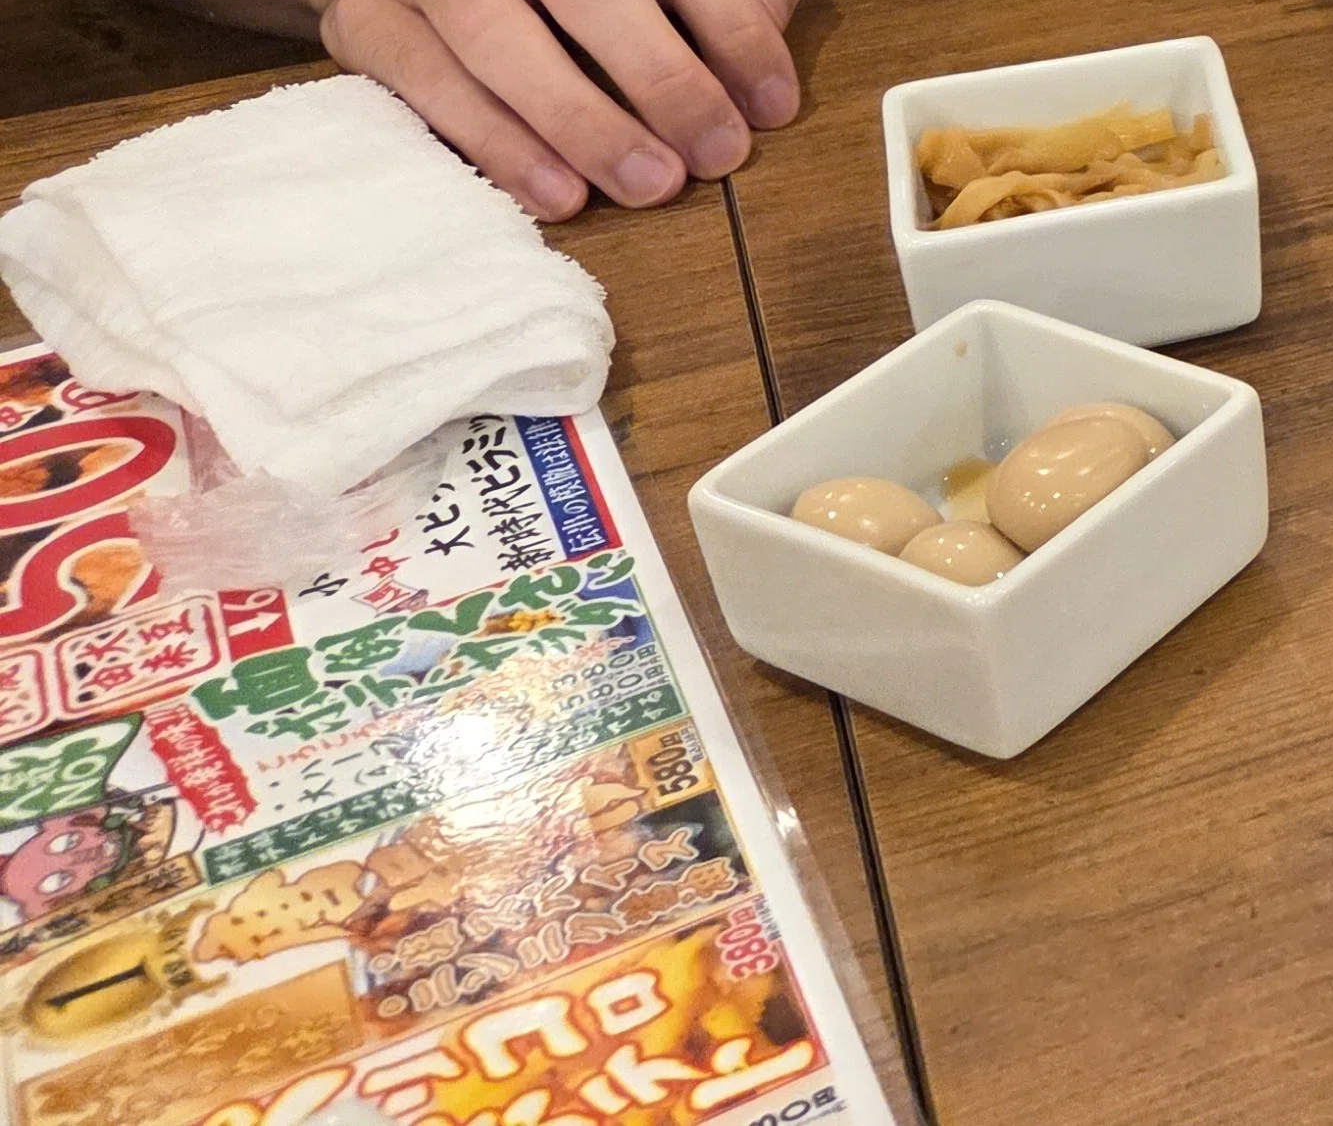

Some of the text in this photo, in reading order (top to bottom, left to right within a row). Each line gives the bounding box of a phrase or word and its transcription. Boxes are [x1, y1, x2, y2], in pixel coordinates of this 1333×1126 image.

[524, 414, 606, 554] 伝串の模倣は法律
[647, 730, 699, 797] 580円
